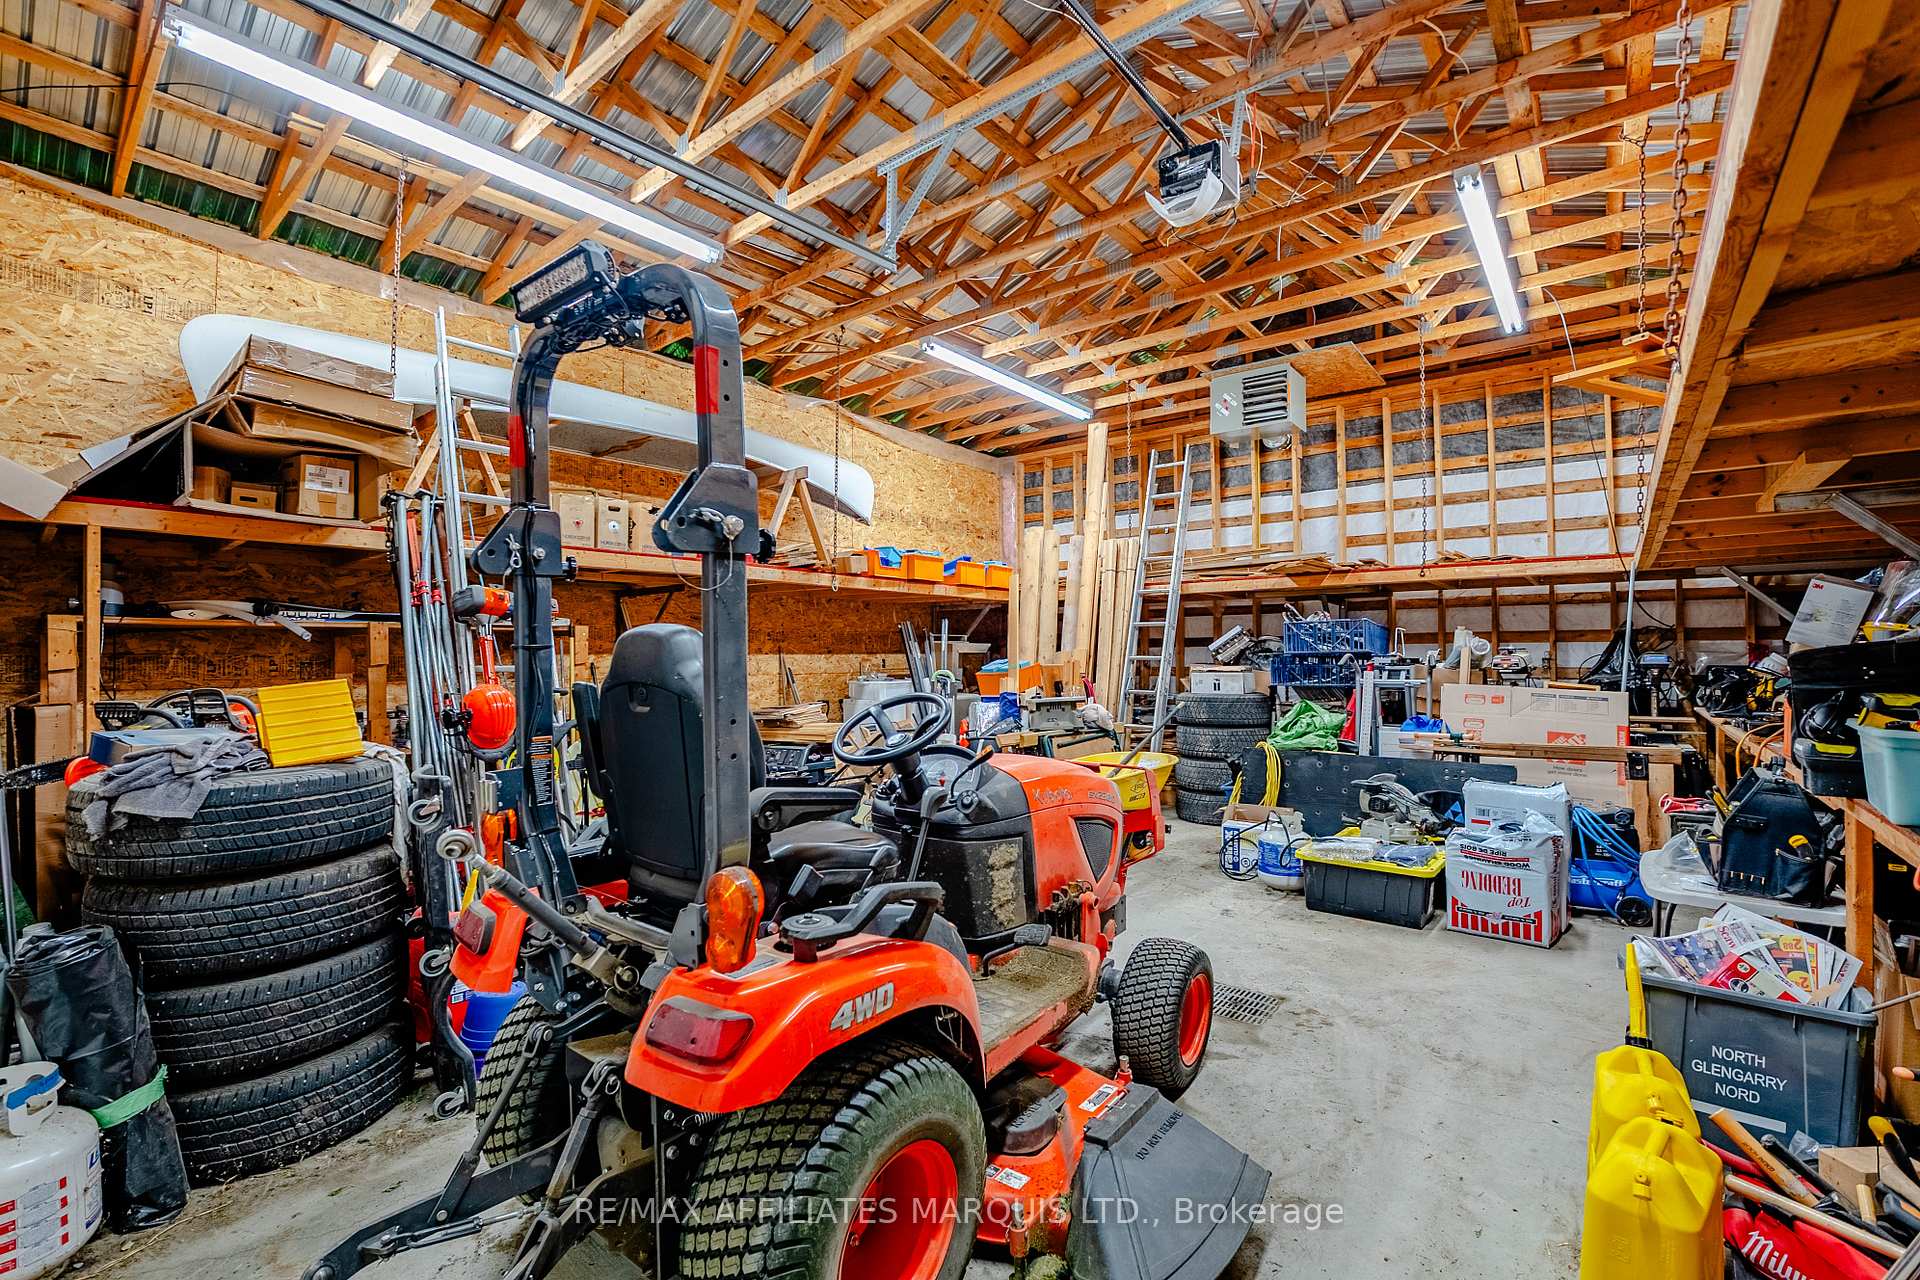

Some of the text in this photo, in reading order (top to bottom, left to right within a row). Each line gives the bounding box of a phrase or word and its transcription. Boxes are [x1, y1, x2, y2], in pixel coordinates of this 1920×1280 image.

[1461, 870, 1522, 897] BEDDING
[829, 981, 895, 1031] 4WD
[1711, 1045, 1766, 1069] NORTH
[1691, 1059, 1788, 1092] GLENGARRY
[1715, 1082, 1761, 1104] NORD
[1134, 1145, 1150, 1161] DO
[1147, 1131, 1163, 1150] NOT
